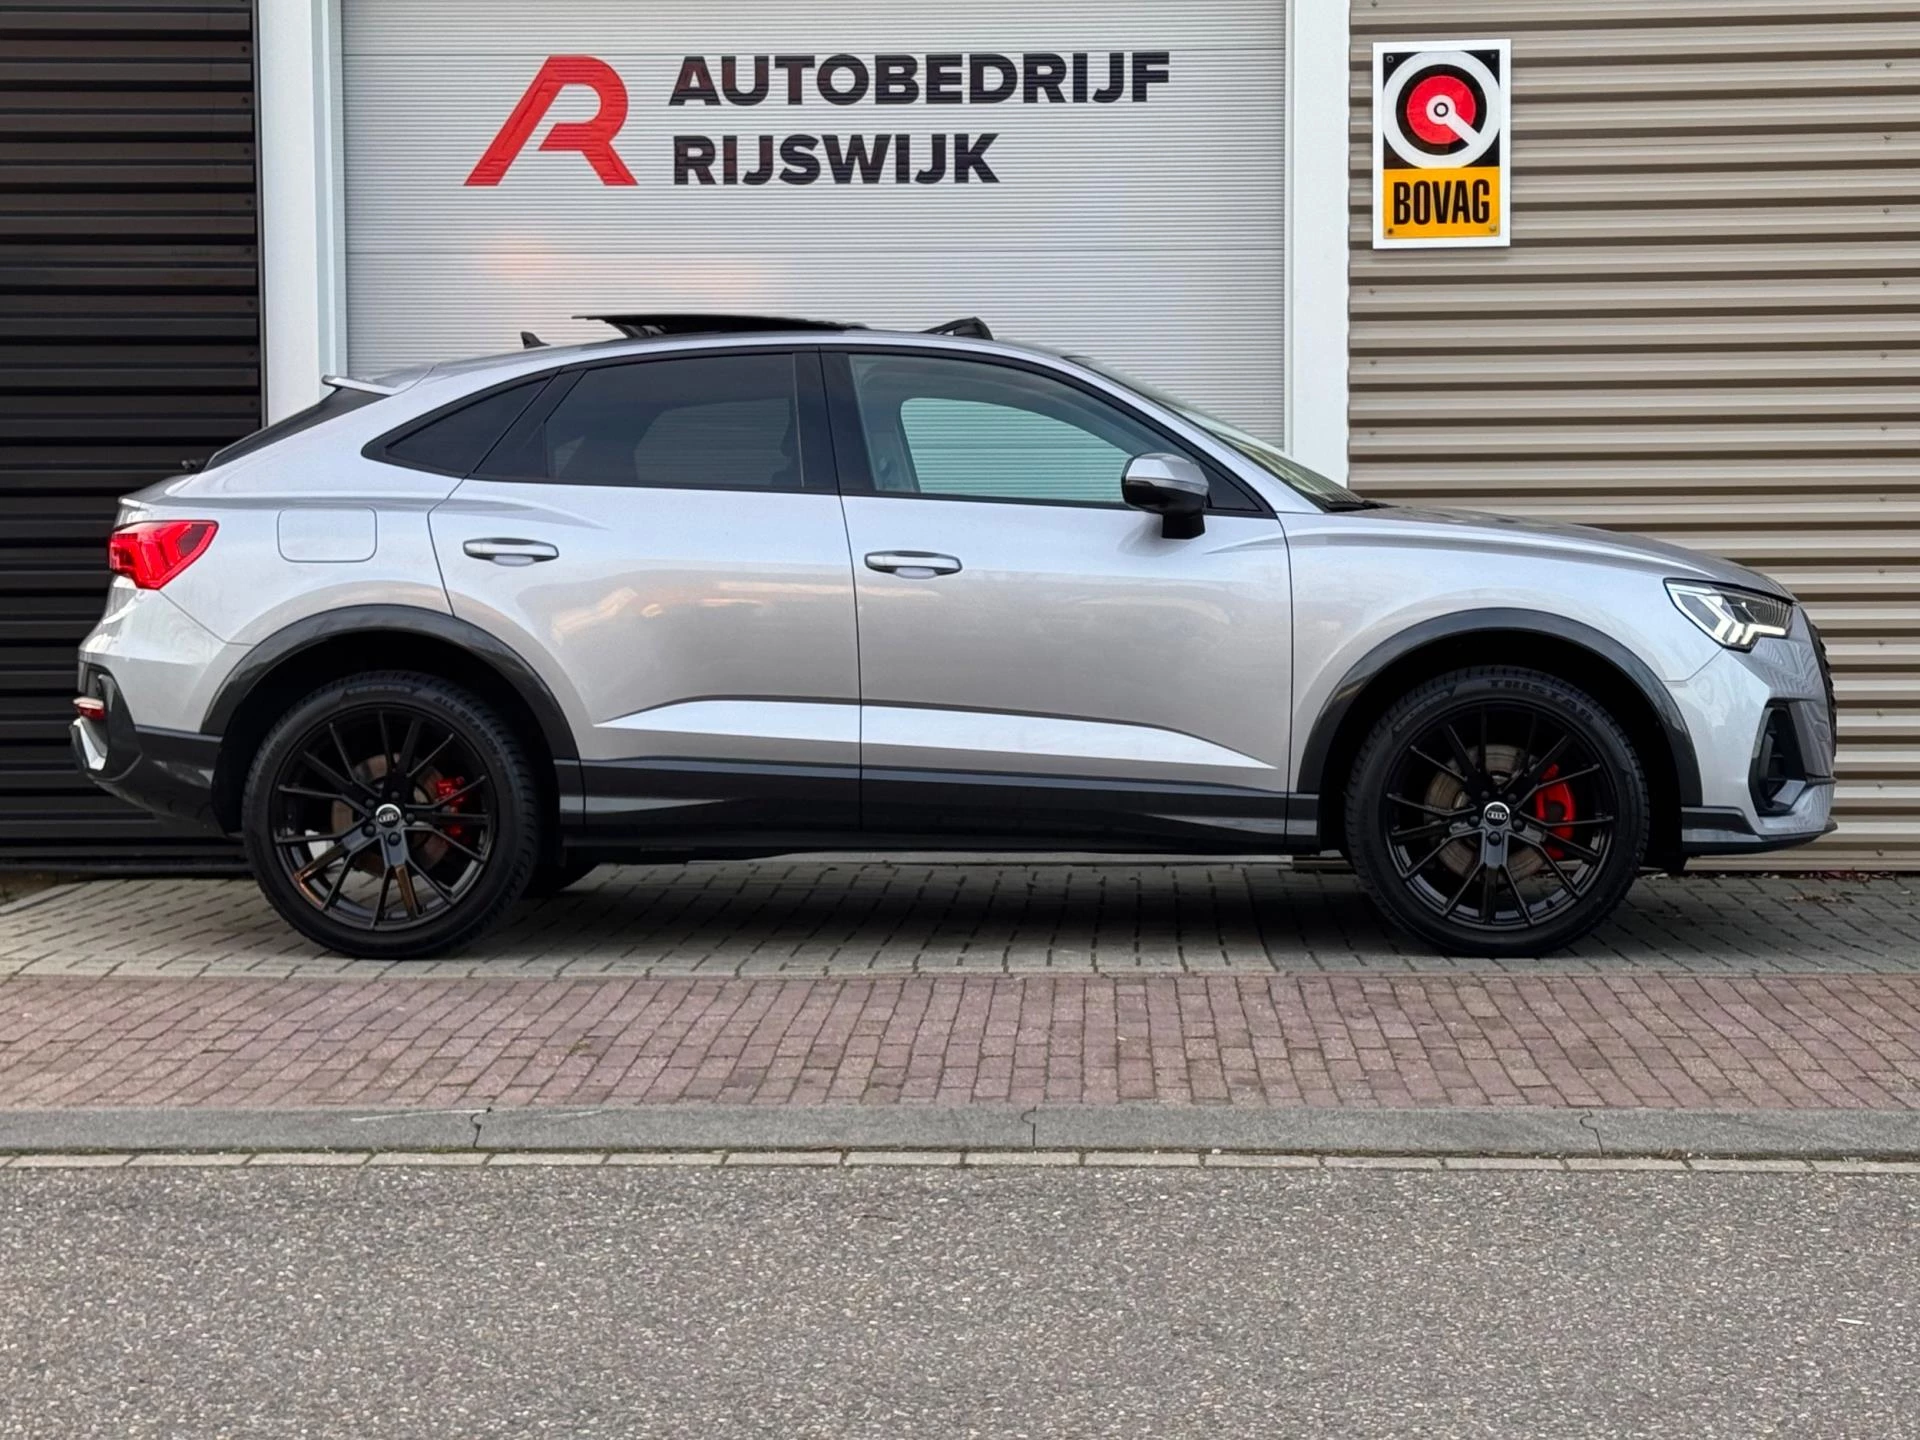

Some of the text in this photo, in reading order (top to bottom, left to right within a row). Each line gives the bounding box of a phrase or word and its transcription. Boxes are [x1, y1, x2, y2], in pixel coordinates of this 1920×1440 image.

[668, 51, 1170, 106] AUTOBEDRIJF
[673, 132, 1001, 186] RIJSWIJK
[1393, 179, 1490, 226] BOVAG
